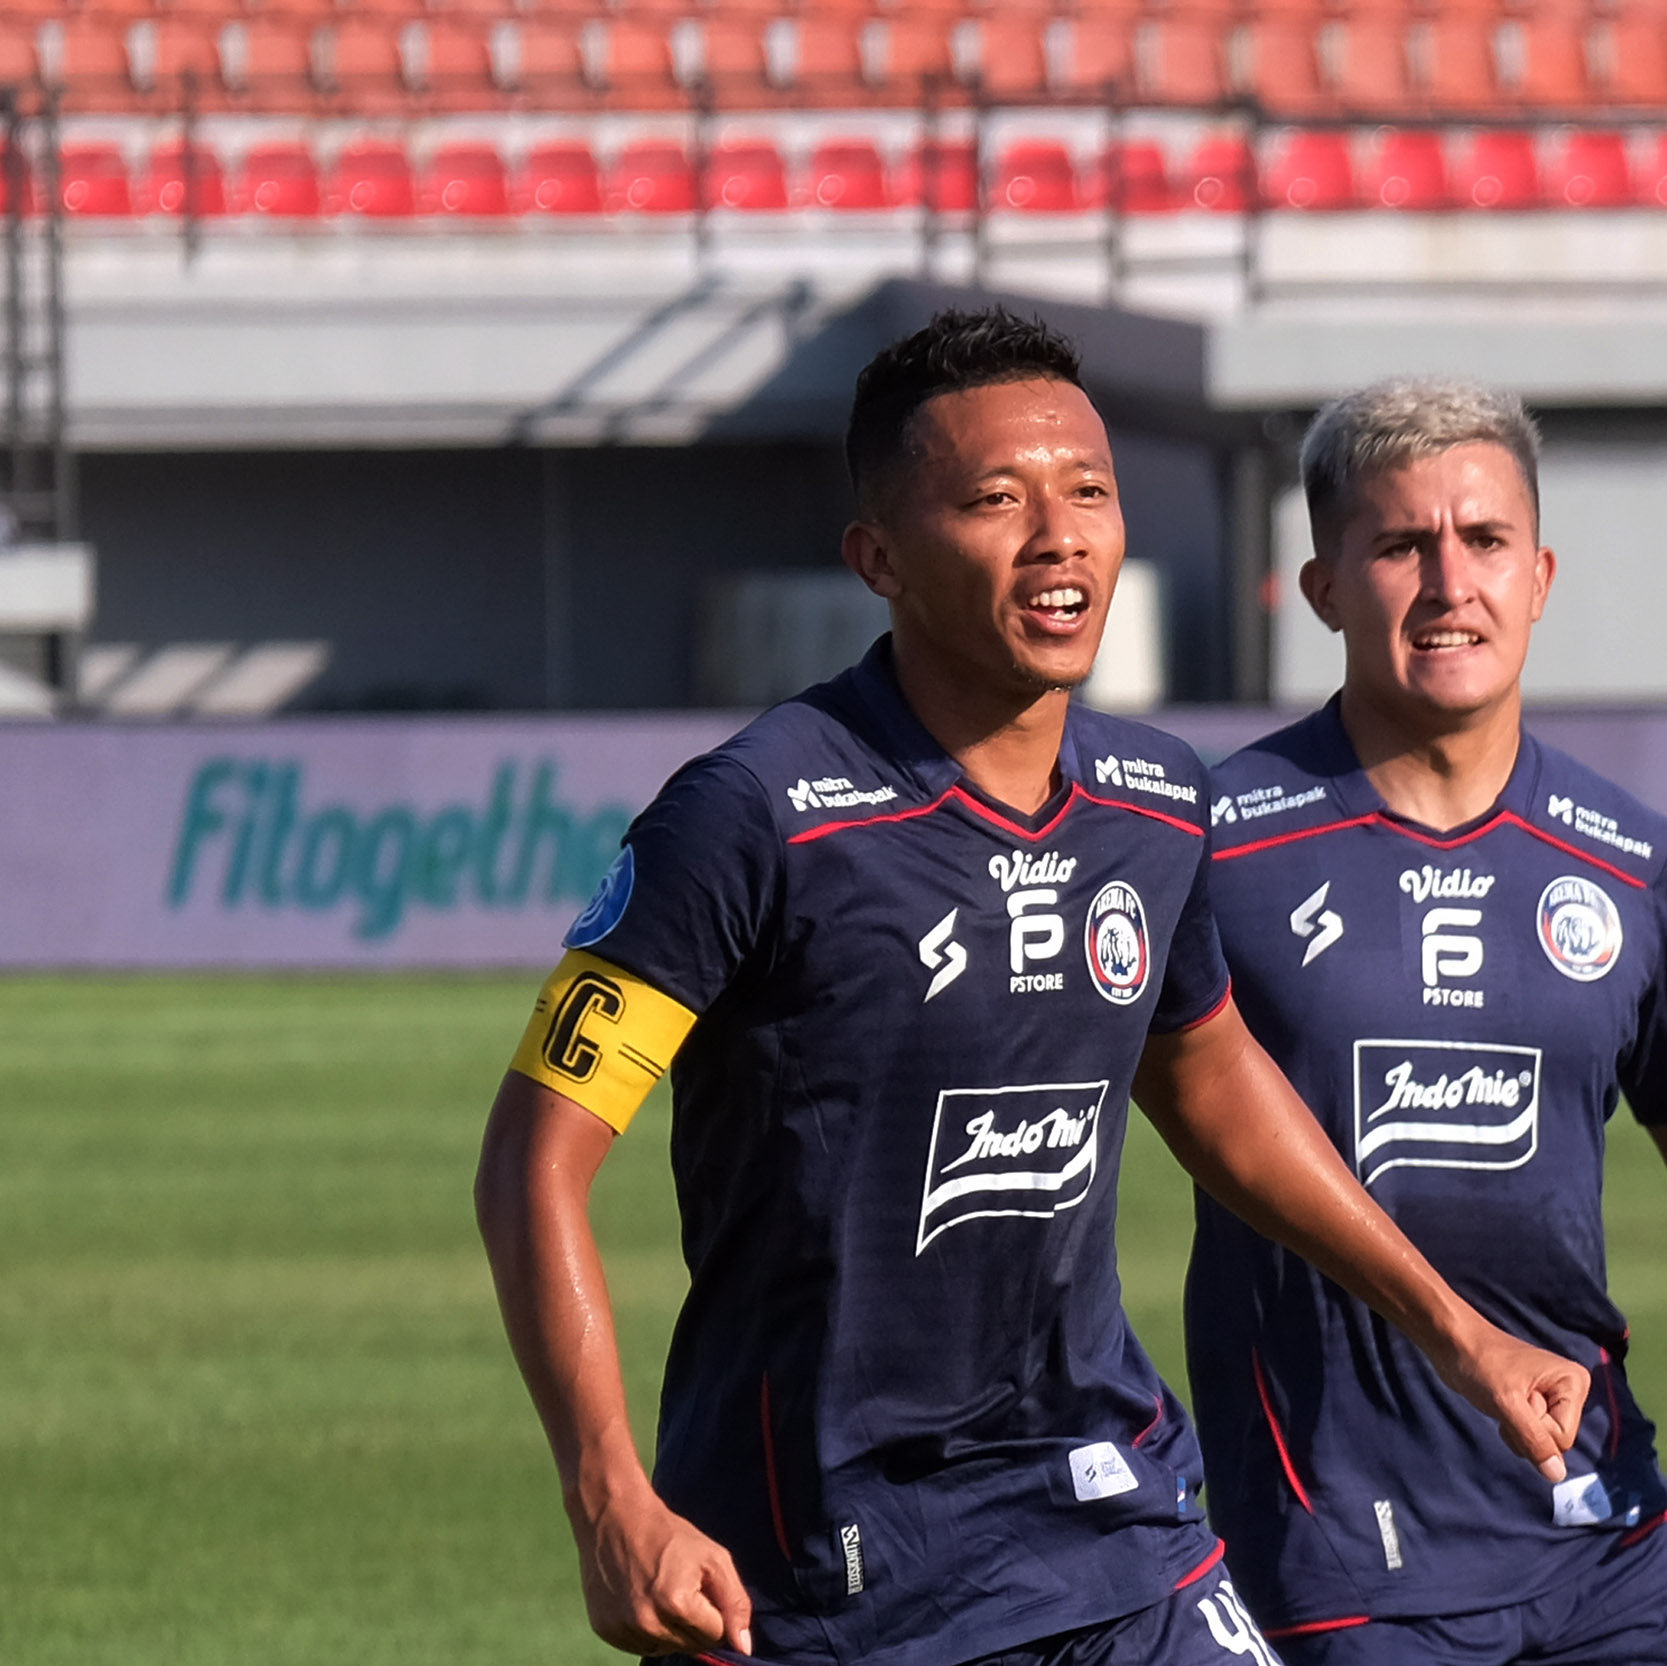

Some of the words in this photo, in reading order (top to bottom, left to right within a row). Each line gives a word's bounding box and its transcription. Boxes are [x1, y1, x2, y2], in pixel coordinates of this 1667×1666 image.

[1122, 757, 1165, 778] mitra
[1125, 773, 1197, 804] bukalapak
[1236, 785, 1283, 807] mitra
[1241, 786, 1326, 820] bukalapak
[166, 753, 634, 938] Fitogethe
[988, 850, 1077, 892] Vidio
[1399, 866, 1495, 903] Vidio
[1010, 972, 1063, 992] PSTORE
[1423, 988, 1484, 1009] PSTORE
[544, 970, 625, 1084] C
